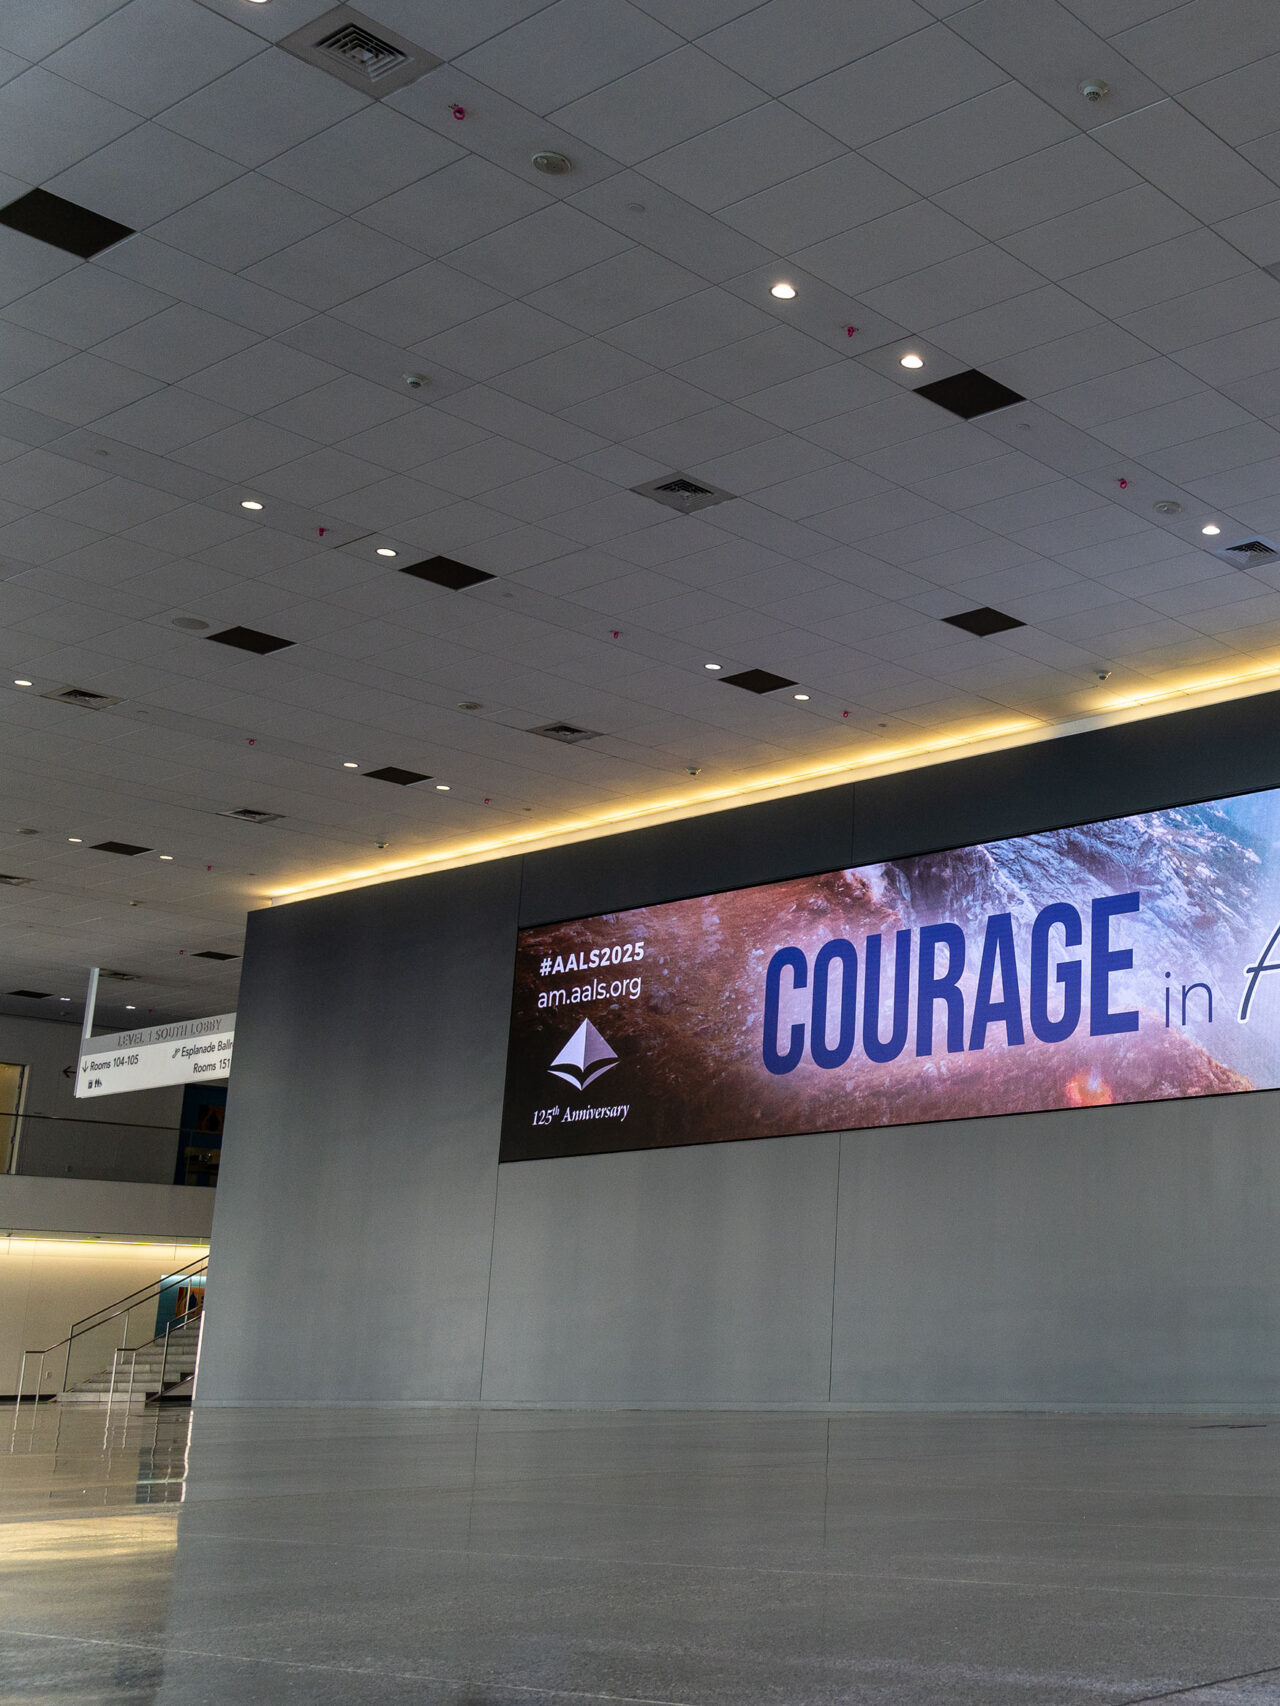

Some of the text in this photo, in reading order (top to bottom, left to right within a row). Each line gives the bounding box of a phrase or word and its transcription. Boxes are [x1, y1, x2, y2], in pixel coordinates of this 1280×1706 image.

[539, 941, 645, 977] #AALS2025
[537, 976, 642, 1009] am.aals.org
[762, 892, 1140, 1075] COURAGE
[1163, 971, 1213, 1027] in
[117, 1032, 144, 1047] LEVEL
[155, 1024, 188, 1040] SOUTH
[190, 1018, 222, 1035] LOBBY
[90, 1054, 139, 1071] Rooms 104-105
[181, 1042, 216, 1059] Esplanade
[193, 1062, 217, 1073] Rooms
[532, 1103, 630, 1126] 125th Anniversary
